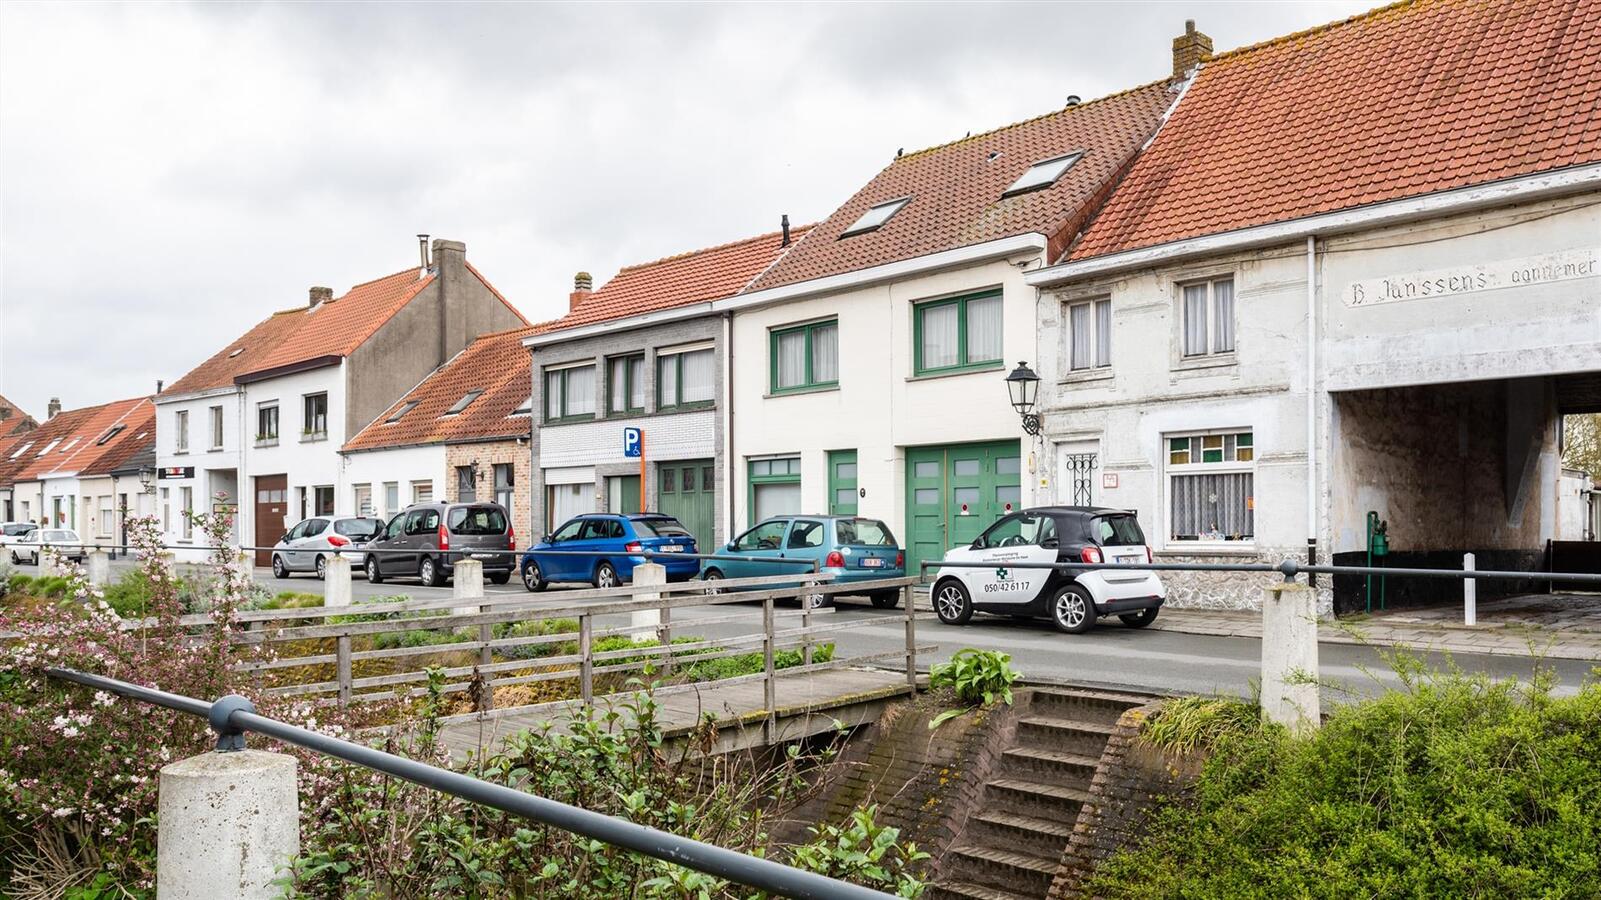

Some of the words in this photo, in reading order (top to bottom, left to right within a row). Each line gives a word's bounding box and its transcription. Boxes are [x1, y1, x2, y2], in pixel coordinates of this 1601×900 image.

[625, 429, 639, 451] P
[984, 583, 1009, 593] 050/42
[1011, 582, 1019, 591] 61
[1021, 581, 1030, 590] 17
